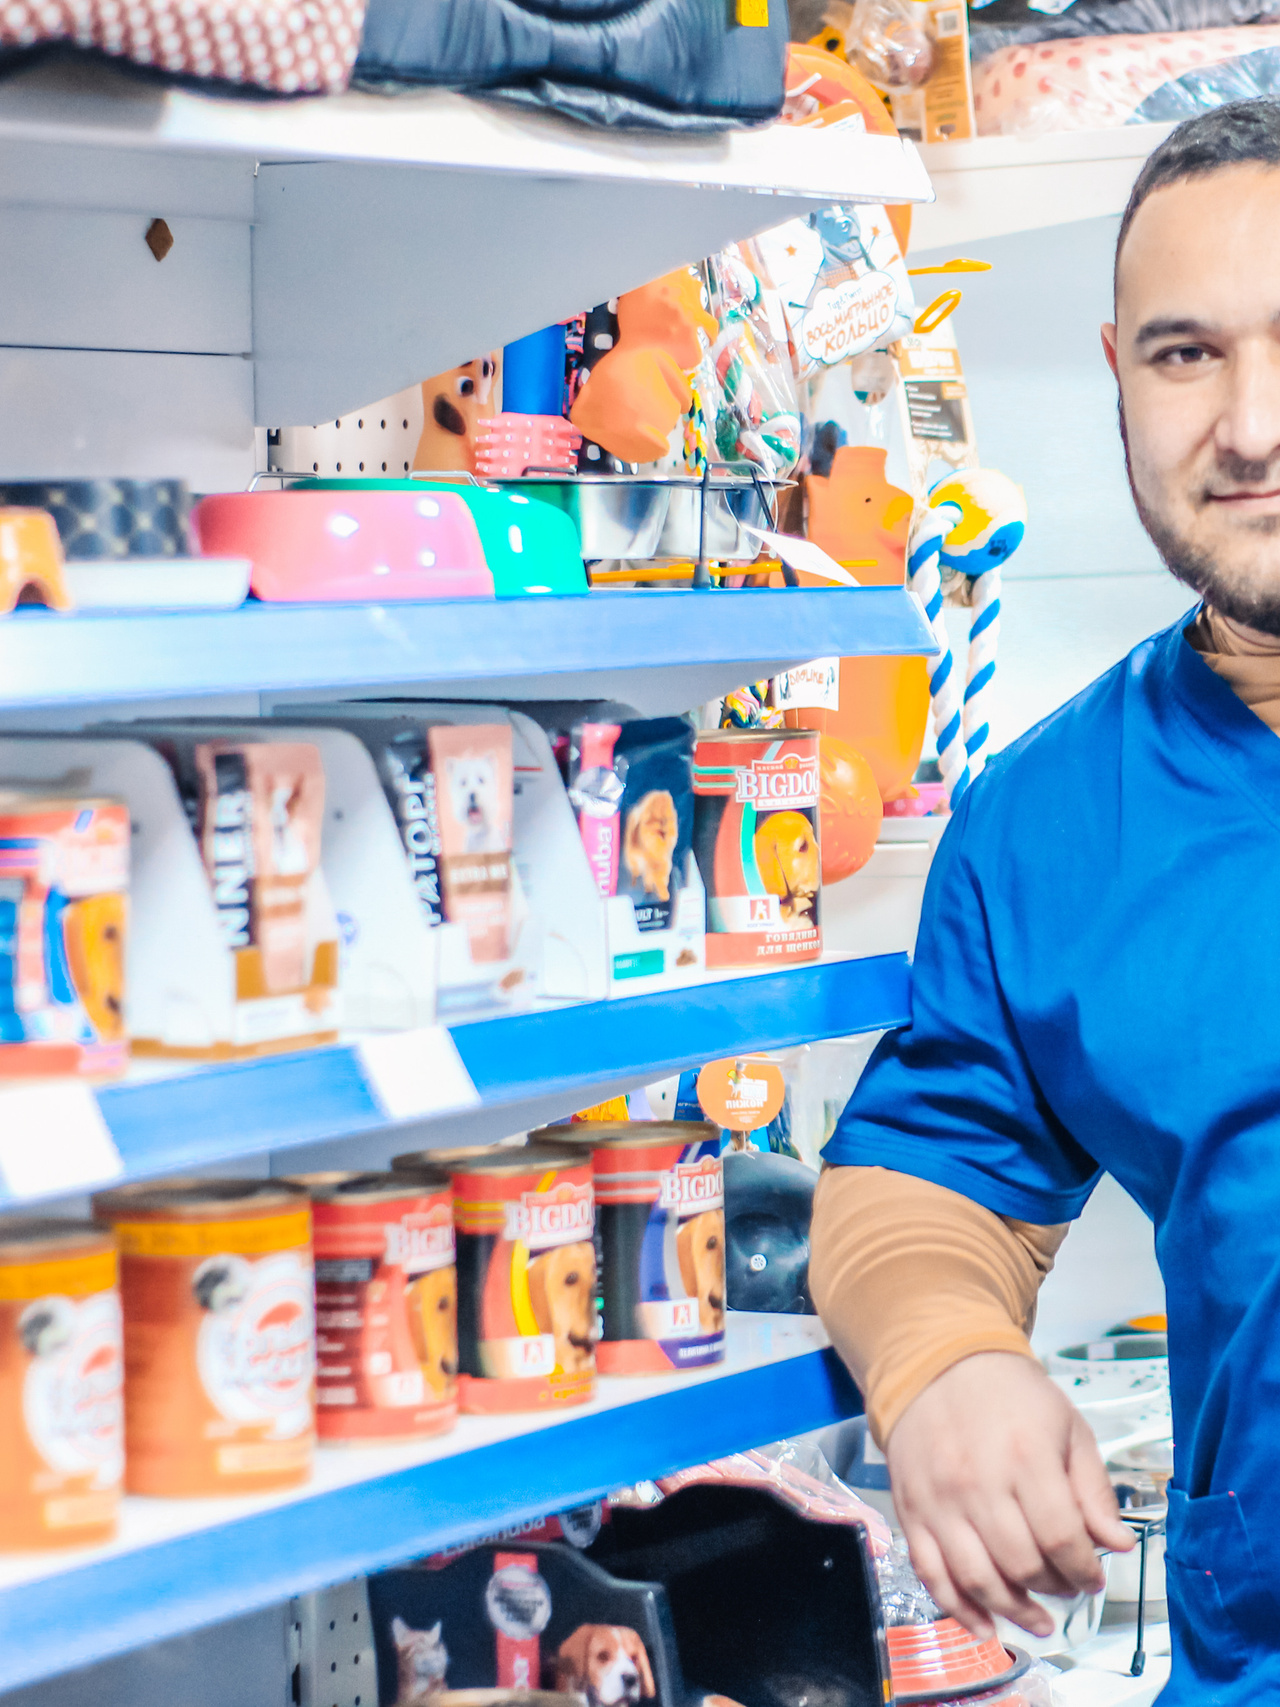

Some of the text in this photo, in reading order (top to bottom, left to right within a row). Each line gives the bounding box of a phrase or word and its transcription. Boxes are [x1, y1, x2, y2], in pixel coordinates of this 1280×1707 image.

[806, 281, 894, 346] ВОСЬМИГРАННОЕ
[824, 303, 889, 357] КОЛЬЦО
[756, 944, 783, 957] для
[765, 928, 818, 944] говядина
